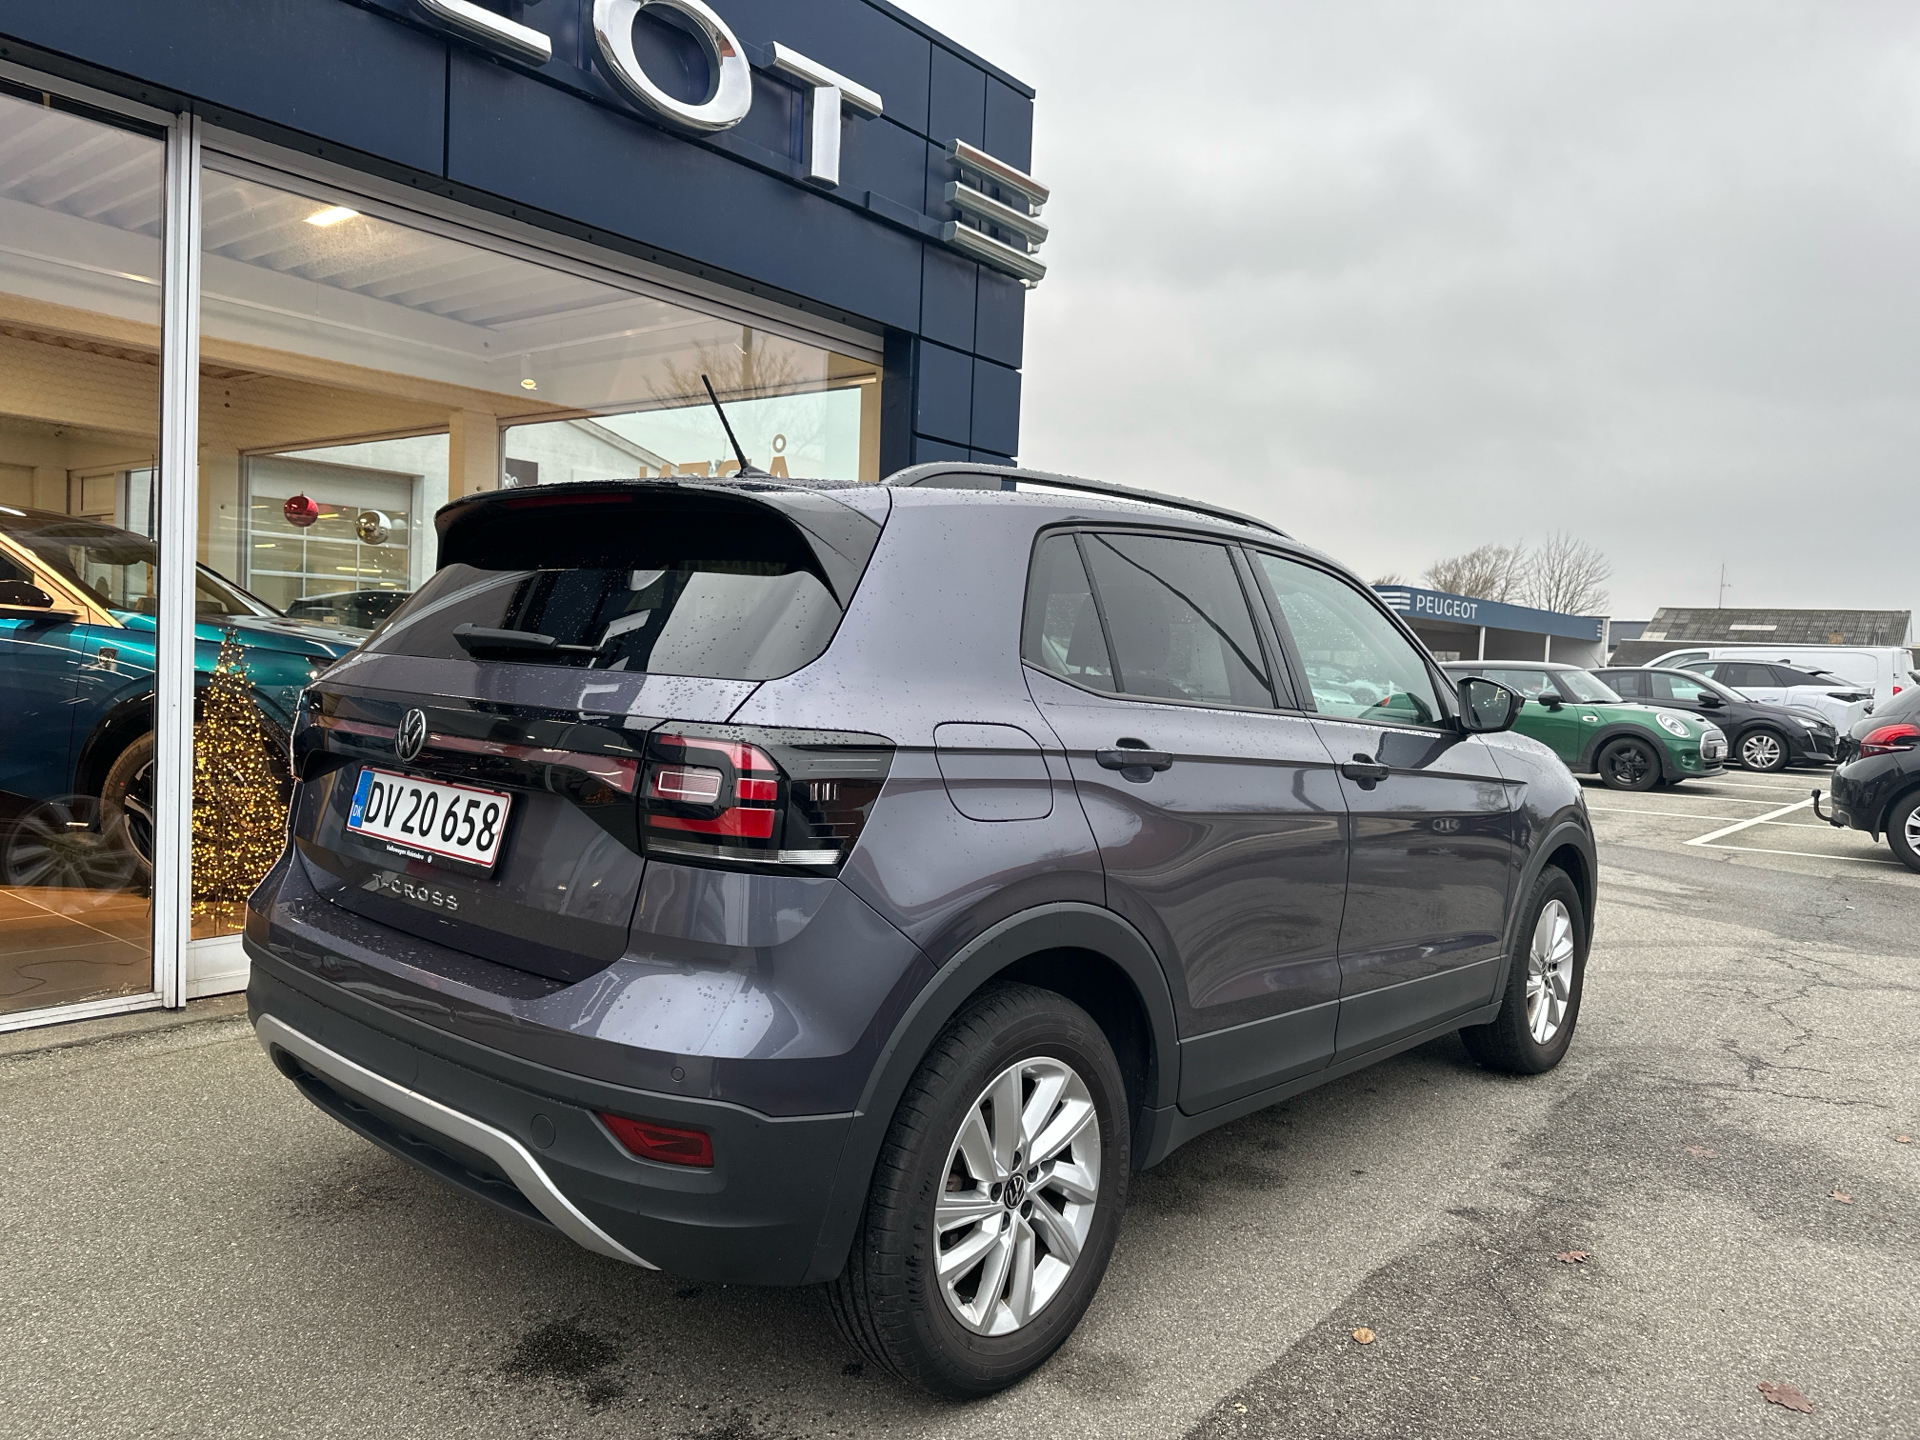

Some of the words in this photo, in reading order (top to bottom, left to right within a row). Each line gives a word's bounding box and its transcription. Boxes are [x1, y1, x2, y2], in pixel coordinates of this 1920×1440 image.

[414, 0, 882, 189] OT
[1416, 595, 1478, 619] PEUGEOT
[352, 804, 363, 818] DK
[364, 781, 404, 828] DV
[401, 788, 439, 837] 20
[441, 795, 500, 852] 658
[372, 873, 460, 911] T-CROSS
